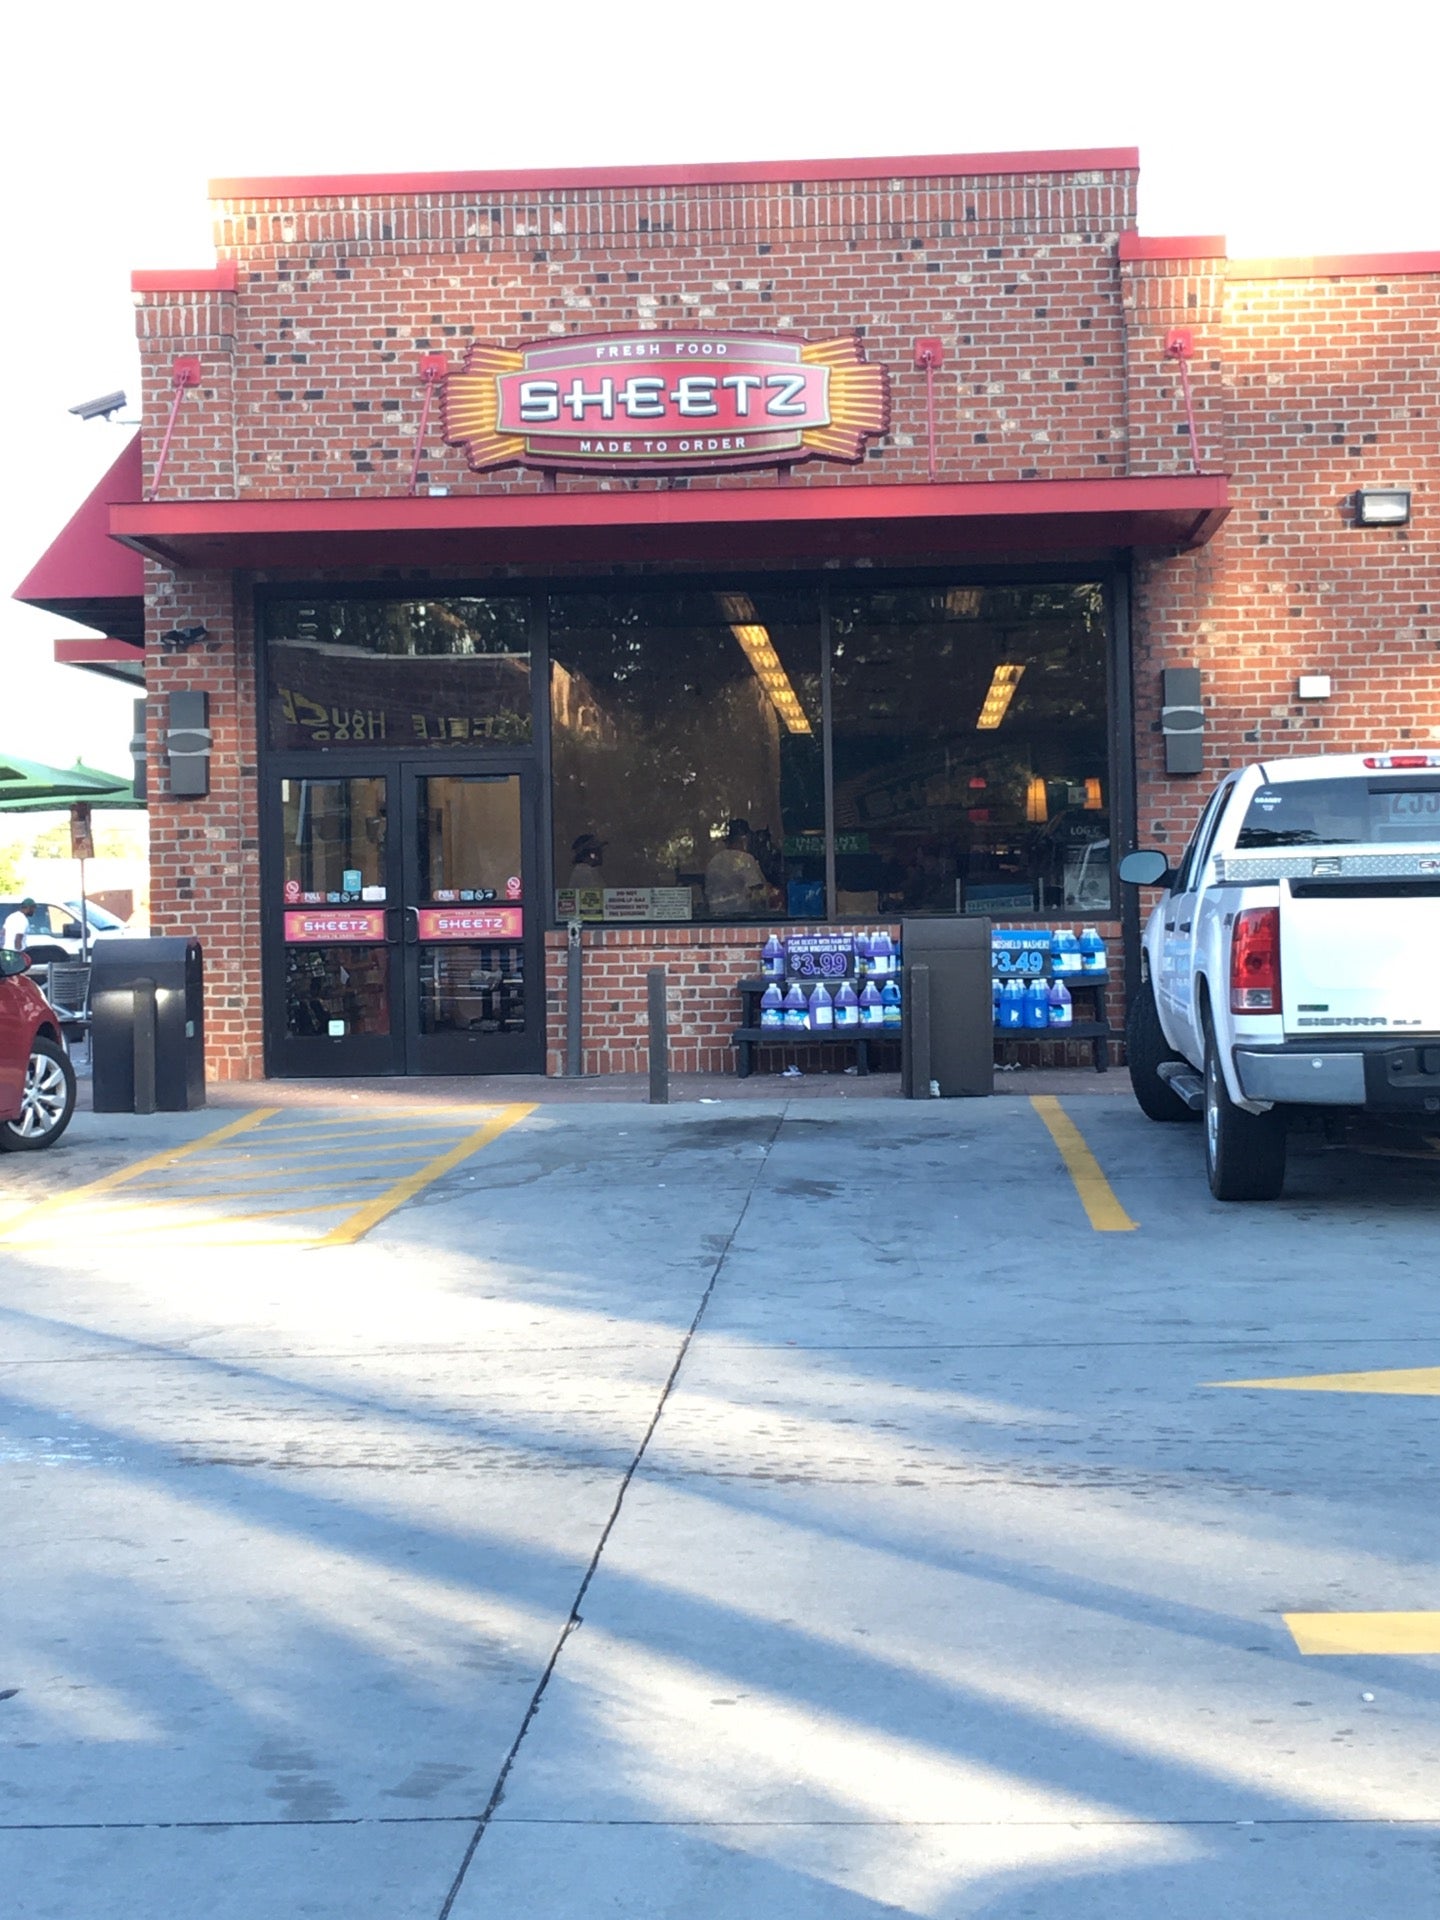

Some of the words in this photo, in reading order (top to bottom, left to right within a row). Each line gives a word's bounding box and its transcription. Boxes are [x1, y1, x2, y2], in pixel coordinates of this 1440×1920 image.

[596, 344, 660, 358] FRESH
[676, 343, 727, 355] FOOD
[520, 374, 806, 421] SHEETZ
[580, 441, 632, 453] MADE
[644, 441, 668, 452] TO
[679, 437, 746, 451] ORDER
[304, 921, 369, 931] SHEETZ
[438, 918, 503, 929] SHEETZ
[791, 952, 847, 975] $3.99
[1298, 1017, 1387, 1026] SIERRA
